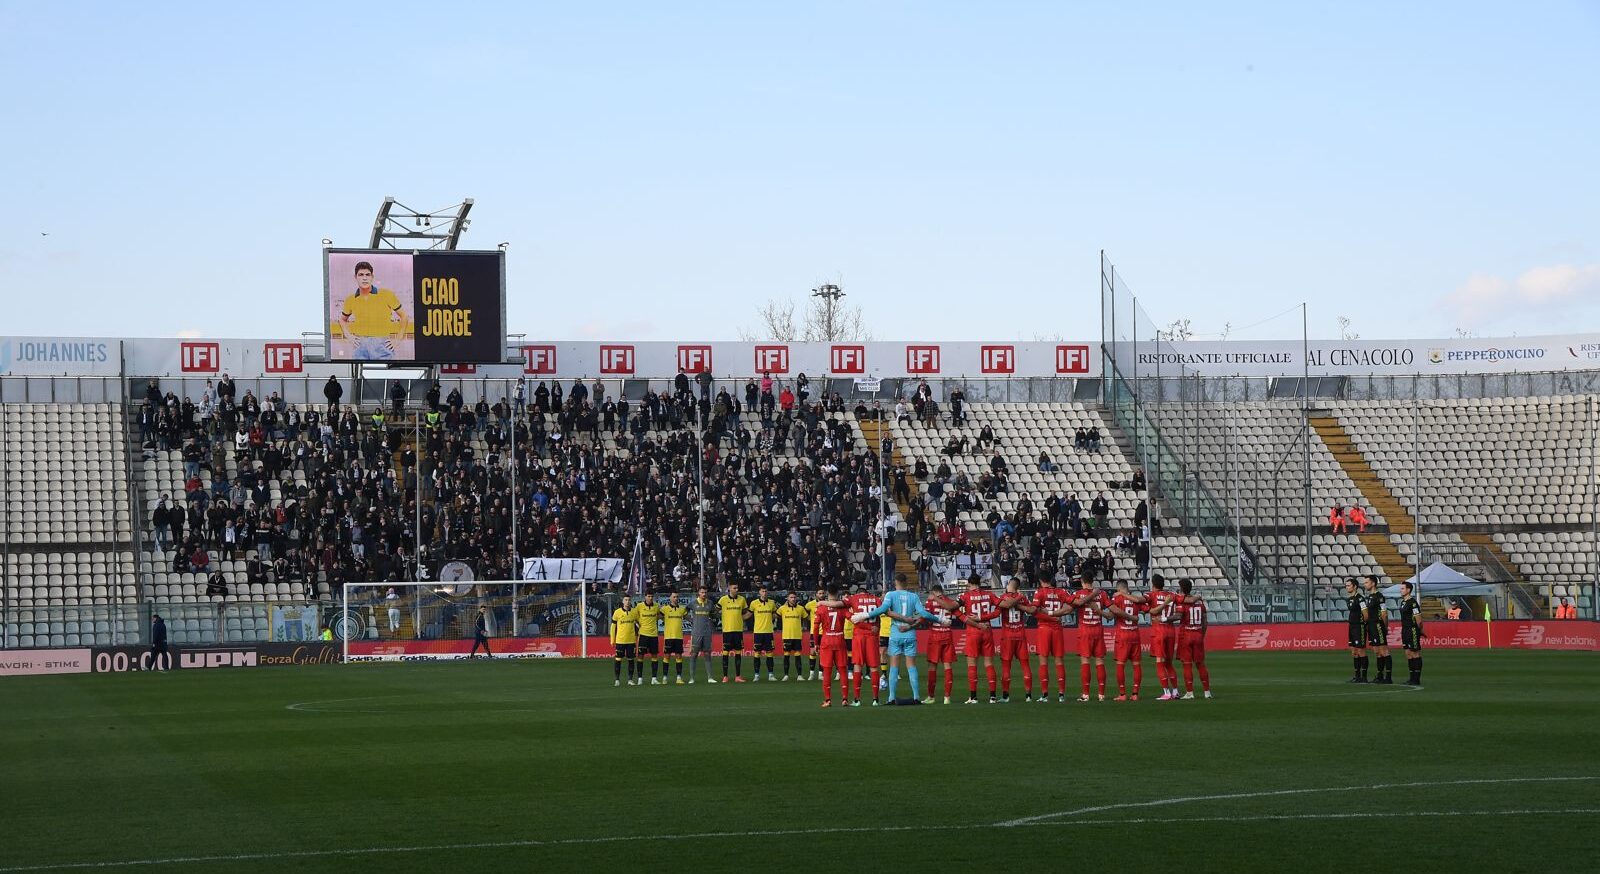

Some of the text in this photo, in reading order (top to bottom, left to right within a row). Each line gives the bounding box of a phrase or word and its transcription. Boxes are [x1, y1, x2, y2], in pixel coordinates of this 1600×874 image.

[422, 278, 459, 306] CIAO
[422, 309, 472, 336] JORGE
[16, 342, 107, 362] JOHANNES
[183, 346, 217, 368] IFI
[267, 347, 300, 369] IFI
[602, 349, 633, 370] IFI
[680, 349, 710, 370] IFI
[757, 350, 786, 370] IFI
[833, 350, 862, 370] IFI
[909, 350, 938, 370] IFI
[983, 350, 1012, 370] IFI
[1058, 350, 1087, 370] IFI
[1139, 353, 1292, 364] RISTORANTE UFFICIALE
[1307, 348, 1414, 366] AL CENACOLO
[1447, 348, 1545, 361] PEPPERONCINO
[828, 612, 838, 631] 7
[1189, 606, 1202, 625] 10
[1270, 638, 1336, 648] new balance
[1433, 636, 1476, 646] balance
[180, 652, 257, 668] UPM
[260, 655, 292, 664] Forza
